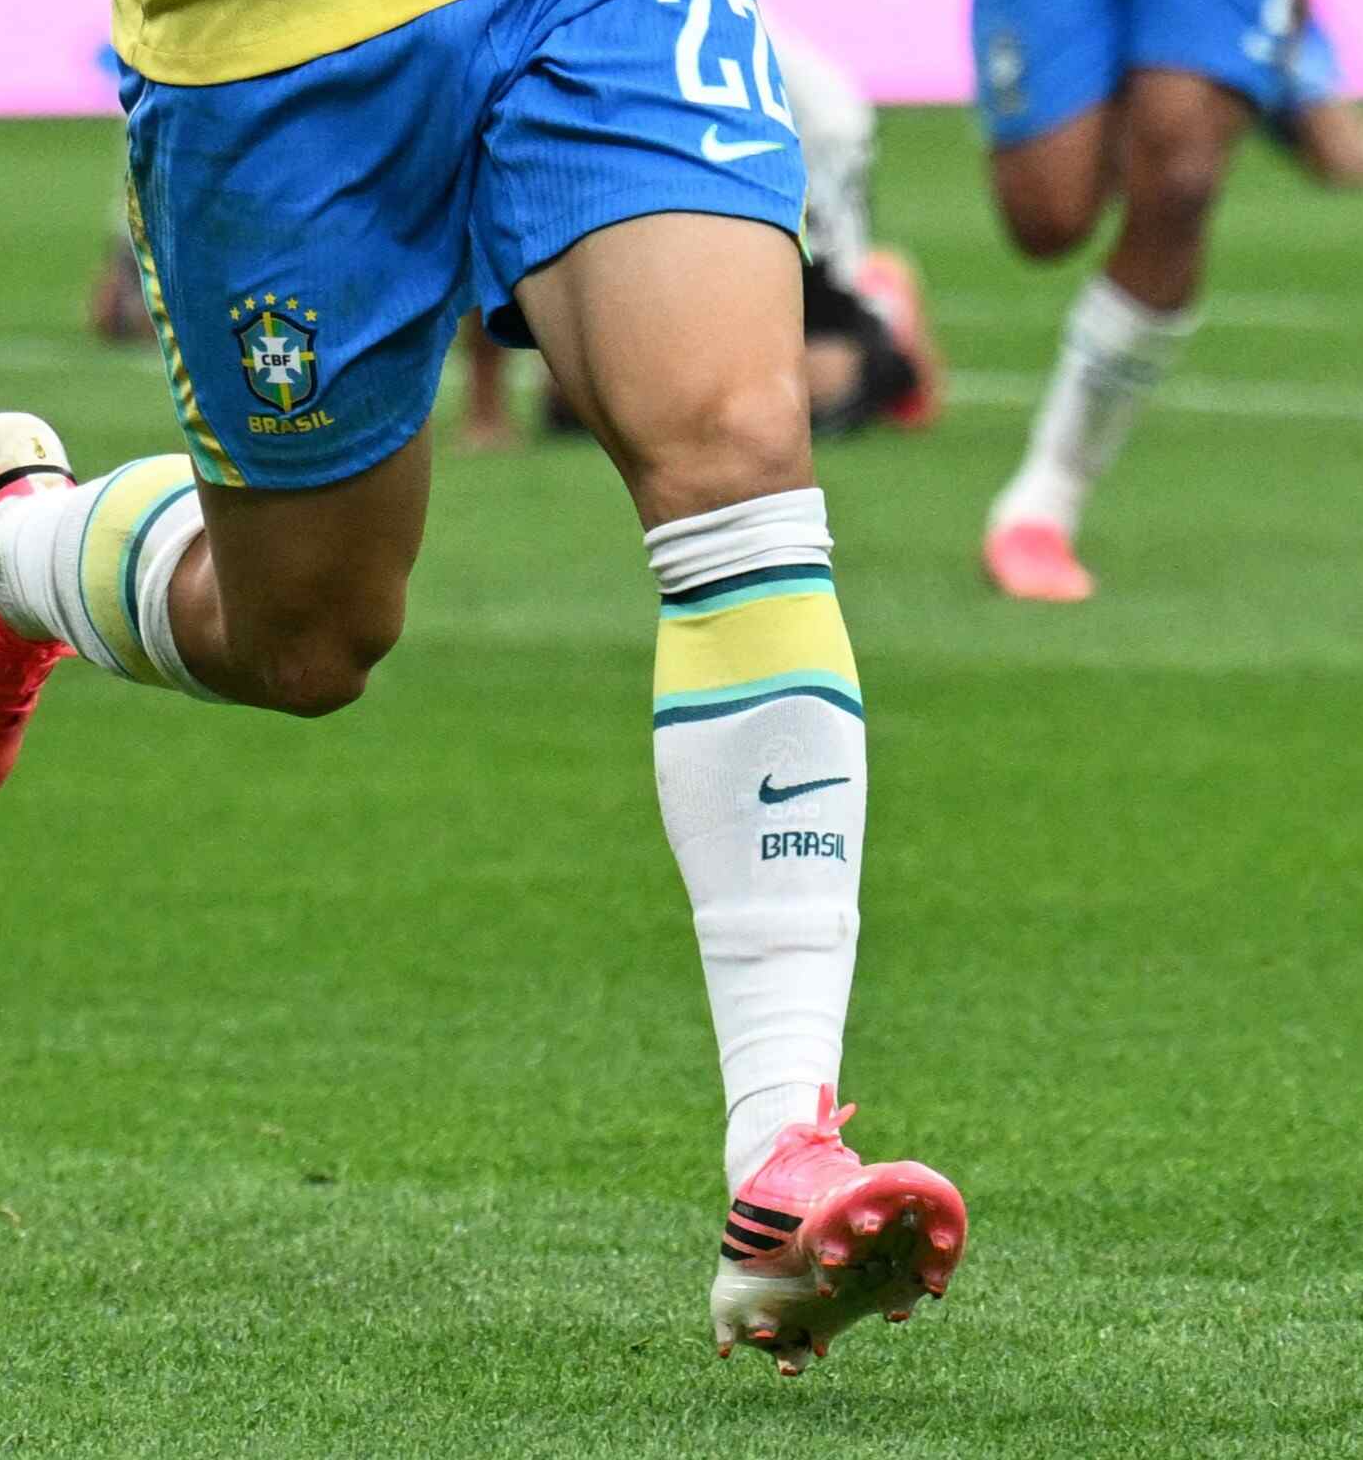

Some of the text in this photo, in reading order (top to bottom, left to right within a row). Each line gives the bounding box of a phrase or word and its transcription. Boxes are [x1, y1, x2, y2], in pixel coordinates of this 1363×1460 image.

[261, 353, 293, 367] CBF
[247, 410, 335, 434] BRASIL
[761, 830, 847, 863] BRASIL
